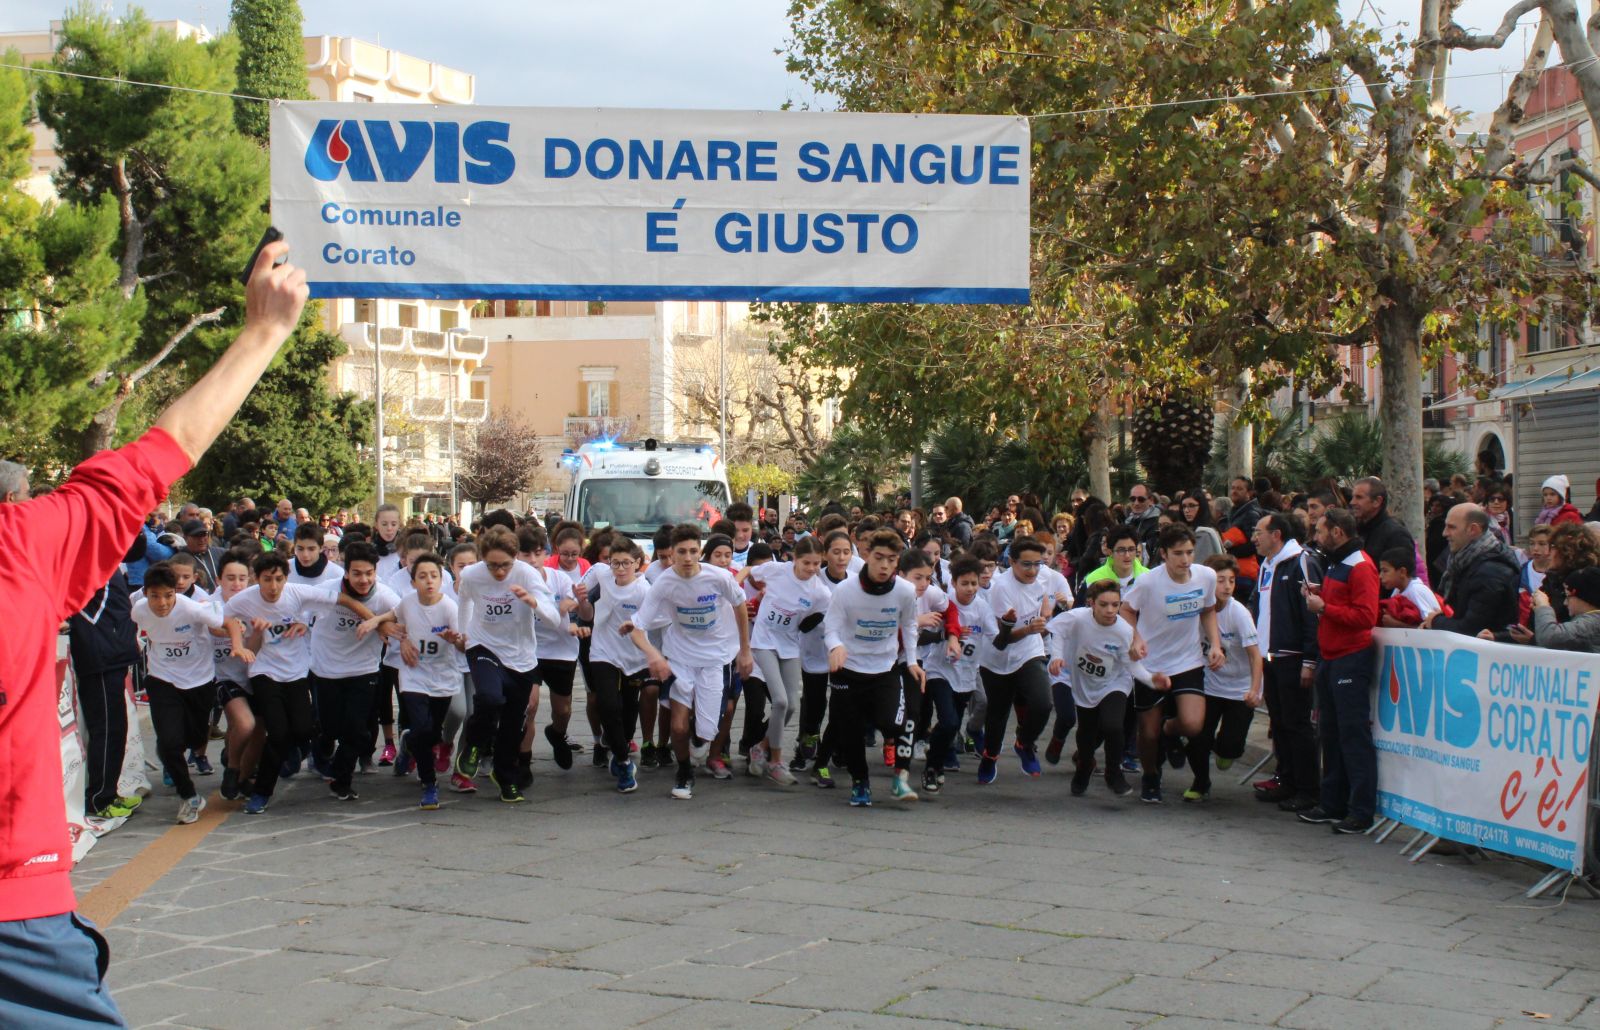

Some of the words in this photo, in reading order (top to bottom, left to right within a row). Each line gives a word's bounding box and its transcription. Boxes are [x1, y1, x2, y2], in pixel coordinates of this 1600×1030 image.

[304, 119, 516, 185] AVIS
[544, 137, 778, 182] DONARE
[797, 141, 1020, 185] SANGUE
[321, 201, 461, 228] Comunale
[646, 198, 687, 252] É
[715, 212, 919, 254] GIUSTO
[322, 243, 416, 266] Corato
[486, 604, 512, 615] 302
[767, 610, 792, 625] 318
[165, 646, 190, 657] 307
[419, 639, 439, 654] 19
[1077, 656, 1106, 677] 299
[1378, 645, 1481, 749] AVIS
[1488, 662, 1591, 708] COMUNALE
[1487, 702, 1591, 764] CORATO
[1450, 756, 1481, 772] SANGUE
